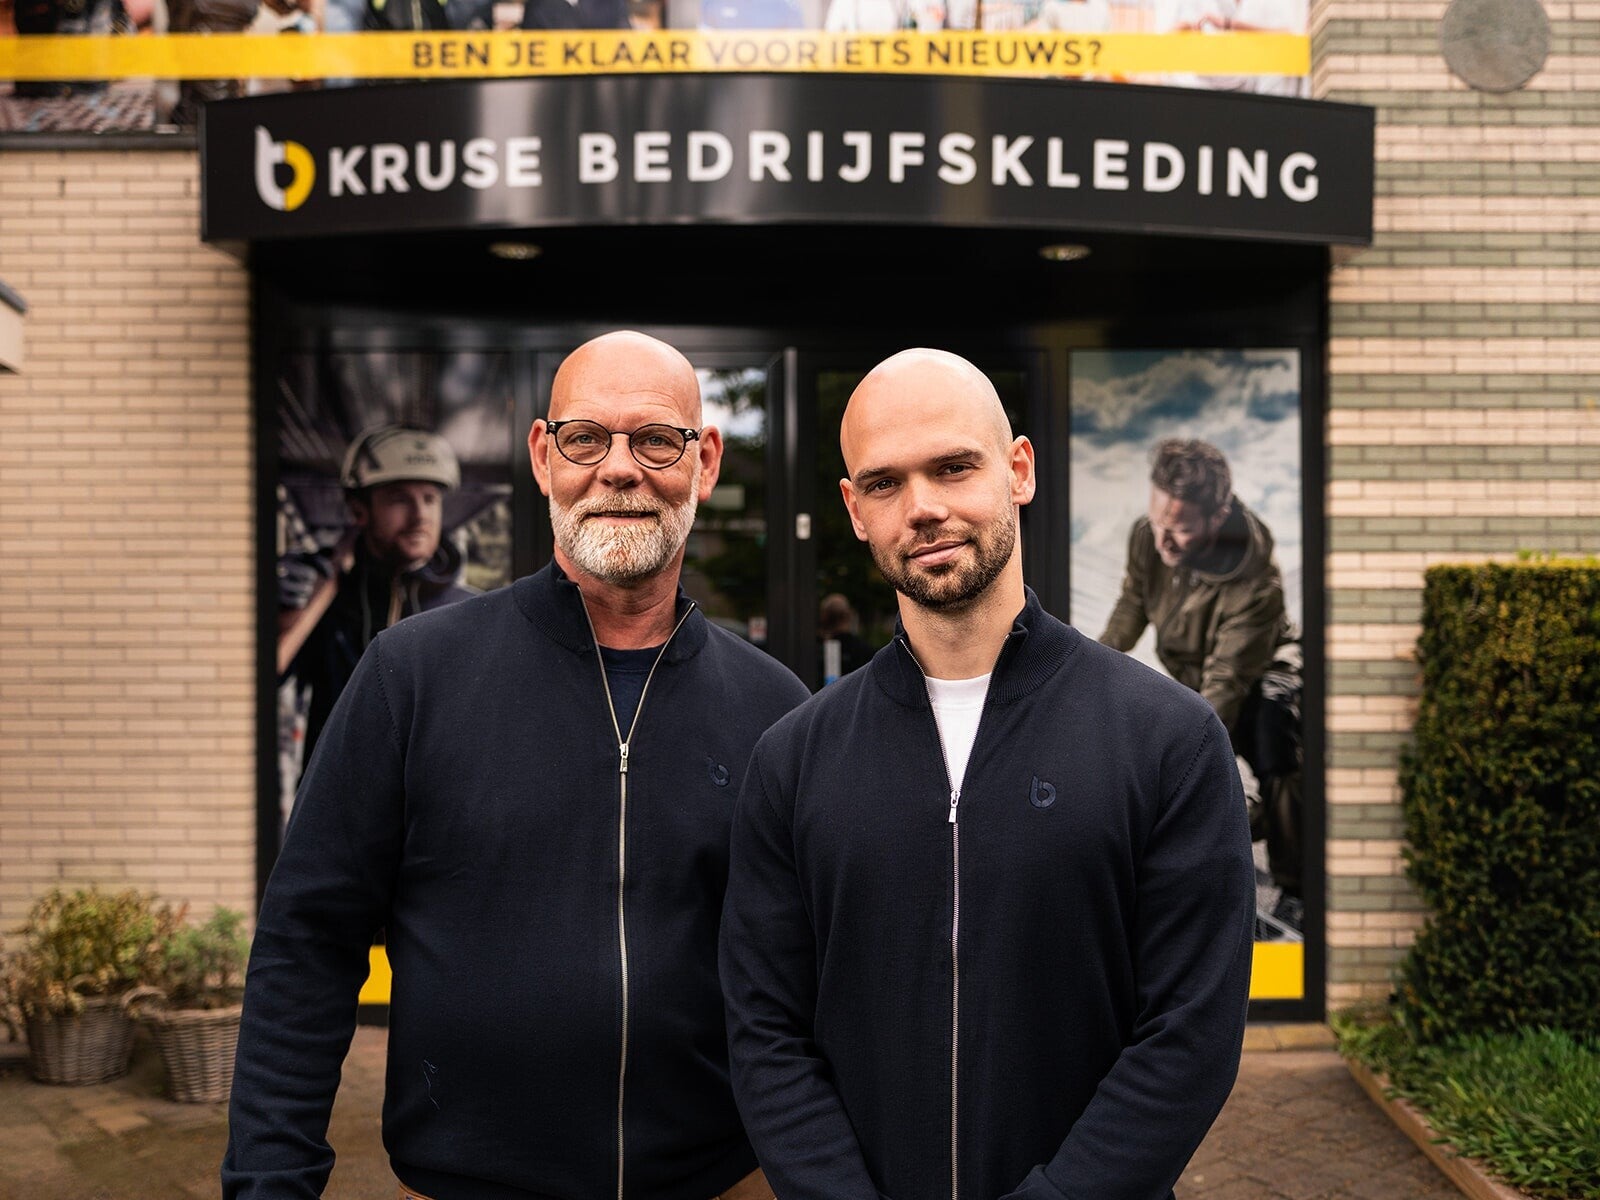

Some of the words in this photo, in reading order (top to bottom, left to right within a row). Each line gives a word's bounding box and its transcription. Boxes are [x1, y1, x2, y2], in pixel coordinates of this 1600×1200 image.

[412, 41, 491, 68] BEN
[505, 41, 546, 67] JE
[562, 41, 691, 66] KLAAR
[705, 40, 818, 65] VOOR
[830, 40, 911, 65] IETS
[926, 40, 1102, 66] NIEUWS?
[328, 136, 543, 197] KRUSE
[578, 131, 1320, 203] BEDRIJFSKLEDING
